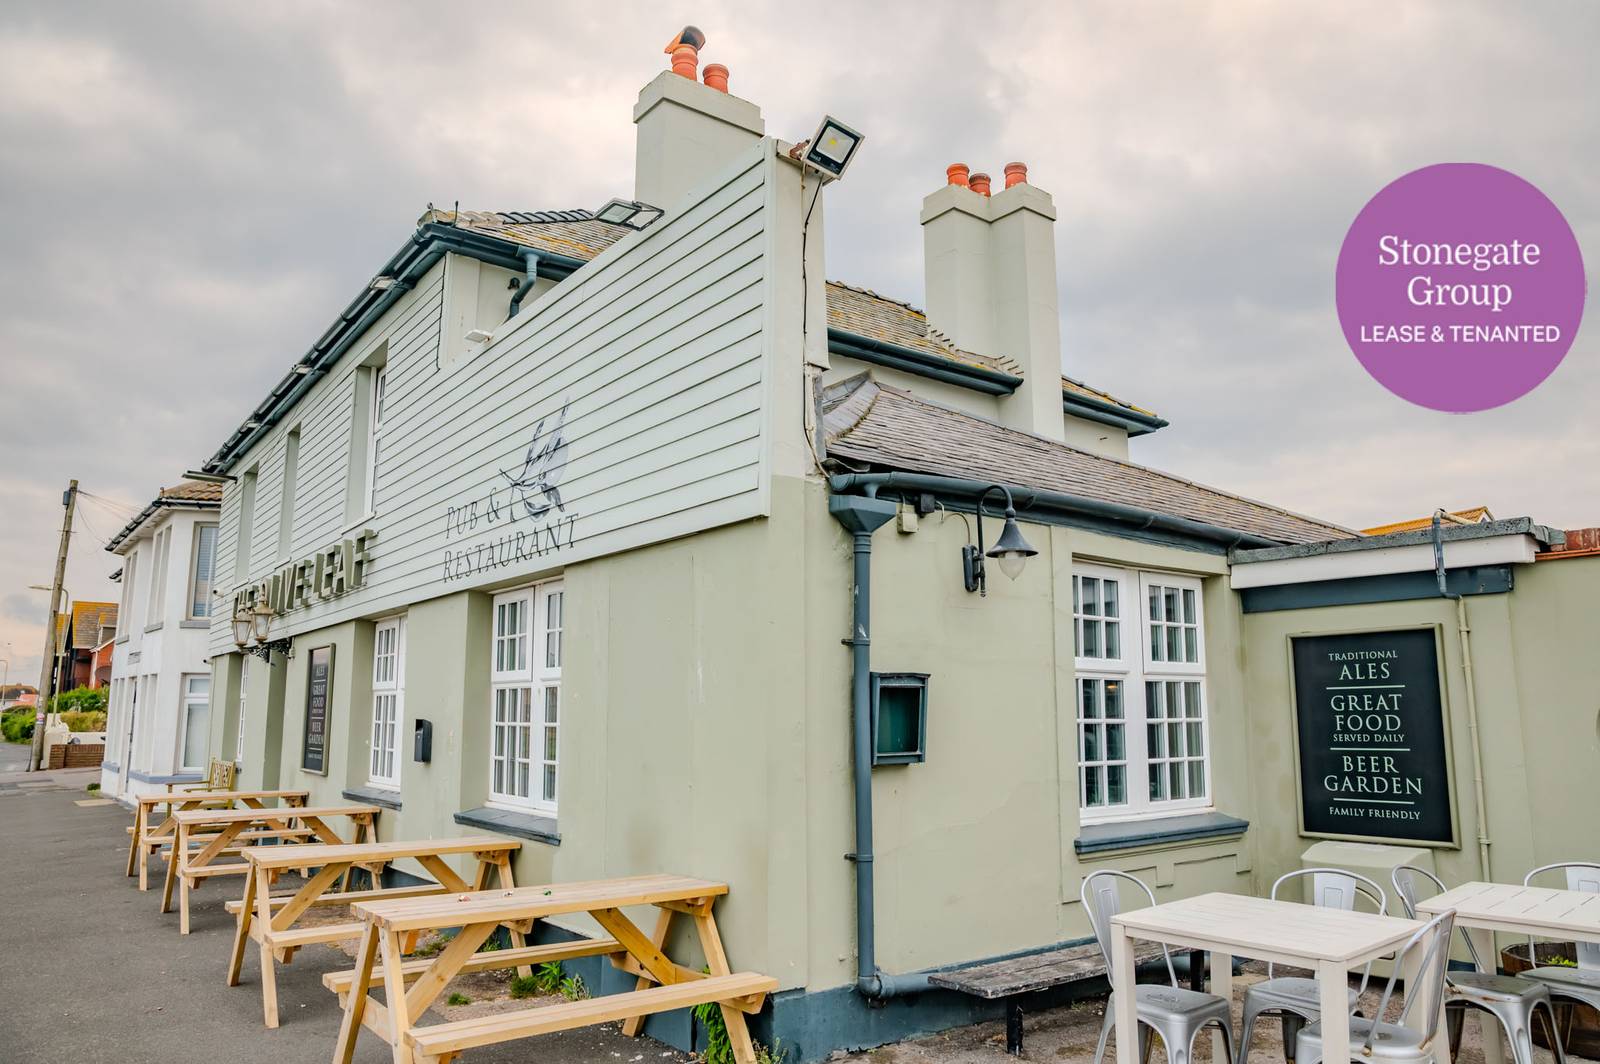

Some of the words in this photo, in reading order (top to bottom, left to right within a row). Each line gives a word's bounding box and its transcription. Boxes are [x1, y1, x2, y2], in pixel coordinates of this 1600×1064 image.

[446, 501, 478, 539] PUB
[487, 487, 500, 524] &
[443, 513, 579, 583] RESTAURANT
[312, 528, 378, 599] LEAF
[1328, 650, 1398, 661] TRADITIONAL
[1339, 663, 1390, 680] ALES
[1331, 694, 1402, 711] GREAT
[1335, 715, 1401, 731] FOOD
[1333, 734, 1370, 742] SERVED
[1375, 734, 1404, 742] DAILY
[1343, 756, 1399, 773] BEER
[1324, 775, 1422, 795] GARDEN
[1329, 807, 1364, 817] FAMILY
[1368, 809, 1421, 820] FRIENDLY
